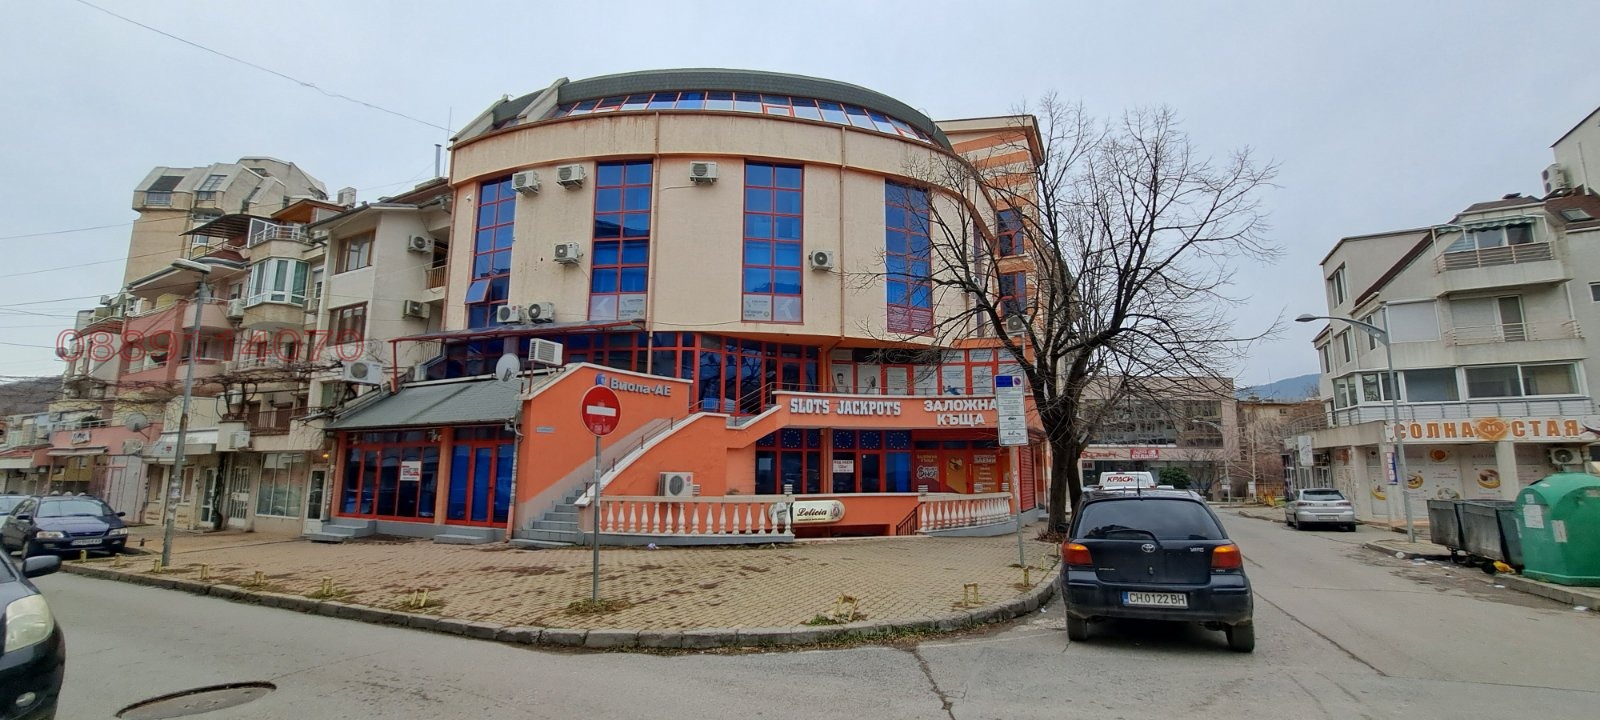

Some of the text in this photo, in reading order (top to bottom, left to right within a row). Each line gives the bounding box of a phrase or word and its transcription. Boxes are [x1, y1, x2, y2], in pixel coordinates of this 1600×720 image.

[611, 378, 671, 396] Виола-АЕ
[790, 398, 902, 416] SLOTS JACKPOTS
[923, 399, 998, 413] ЗАЛОЖНА
[937, 413, 985, 427] КЪЩА
[1393, 419, 1580, 440] СОЛНА СТАЯ
[1145, 593, 1169, 604] 0122
